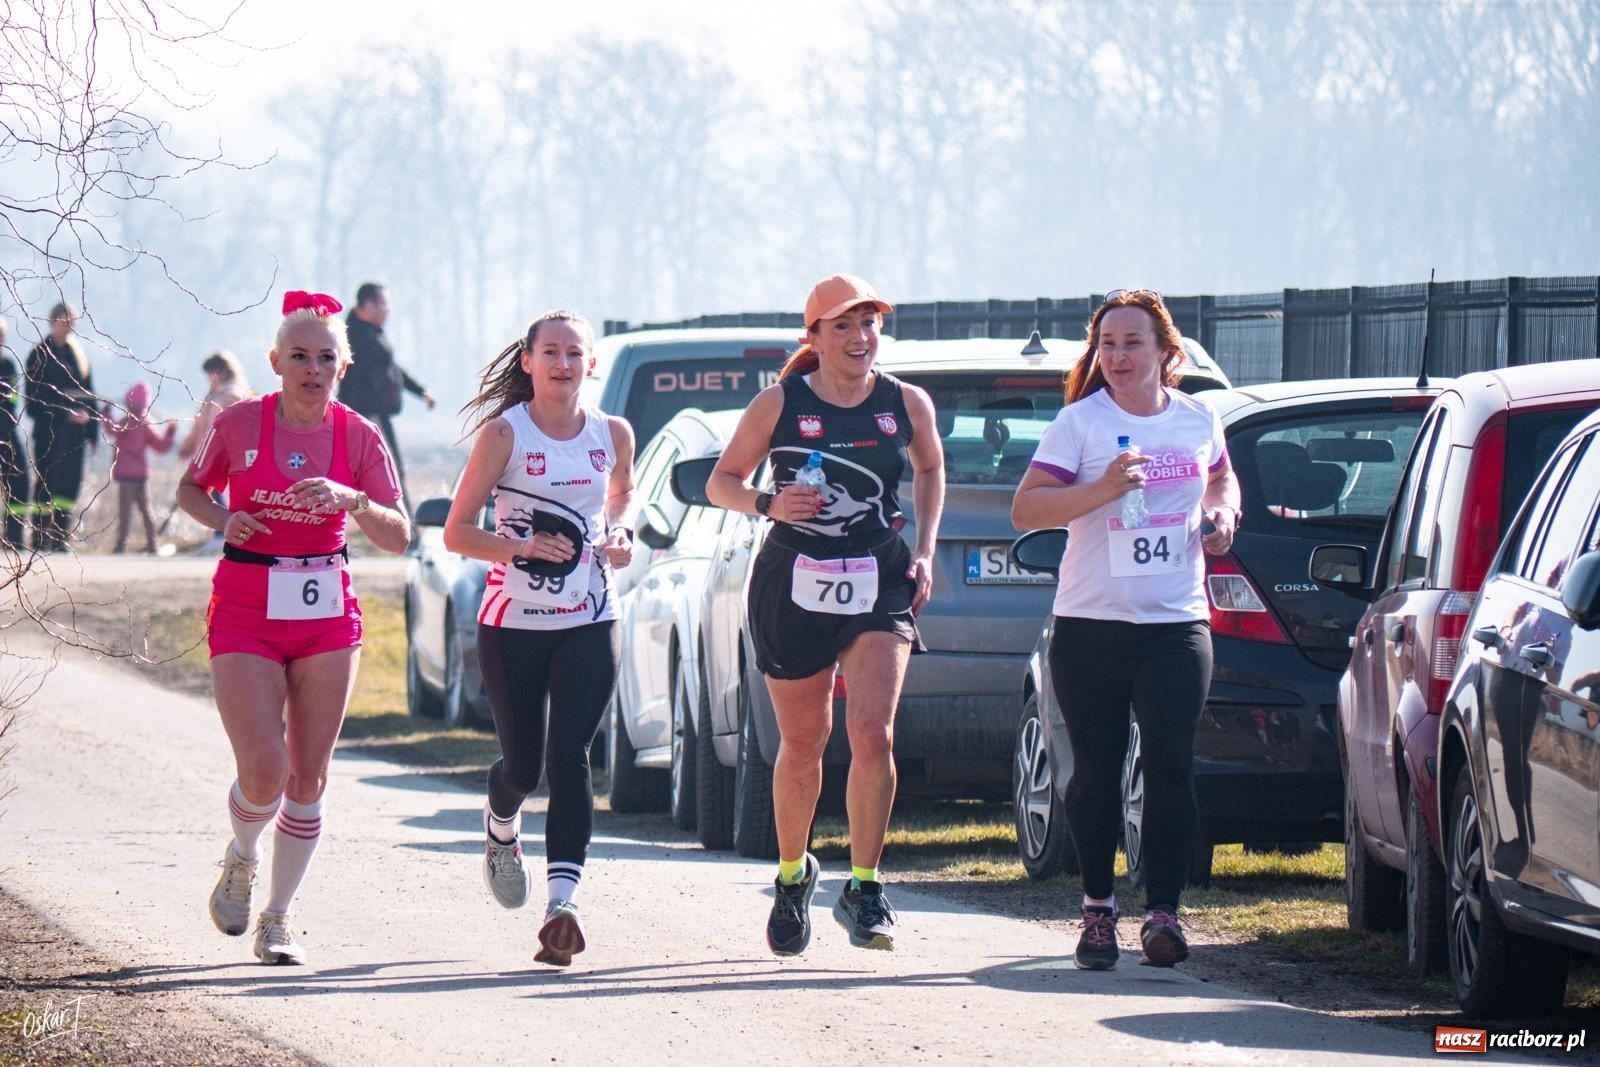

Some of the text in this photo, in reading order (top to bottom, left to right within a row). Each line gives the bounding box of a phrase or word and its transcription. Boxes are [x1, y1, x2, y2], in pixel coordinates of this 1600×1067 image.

[654, 371, 746, 392] DUET
[1140, 452, 1176, 468] IEG
[1140, 464, 1193, 480] KOBIET
[1133, 536, 1170, 564] 84
[968, 566, 979, 574] PL
[302, 578, 319, 606] 6
[815, 579, 853, 605] 70
[1274, 583, 1320, 592] CORSA
